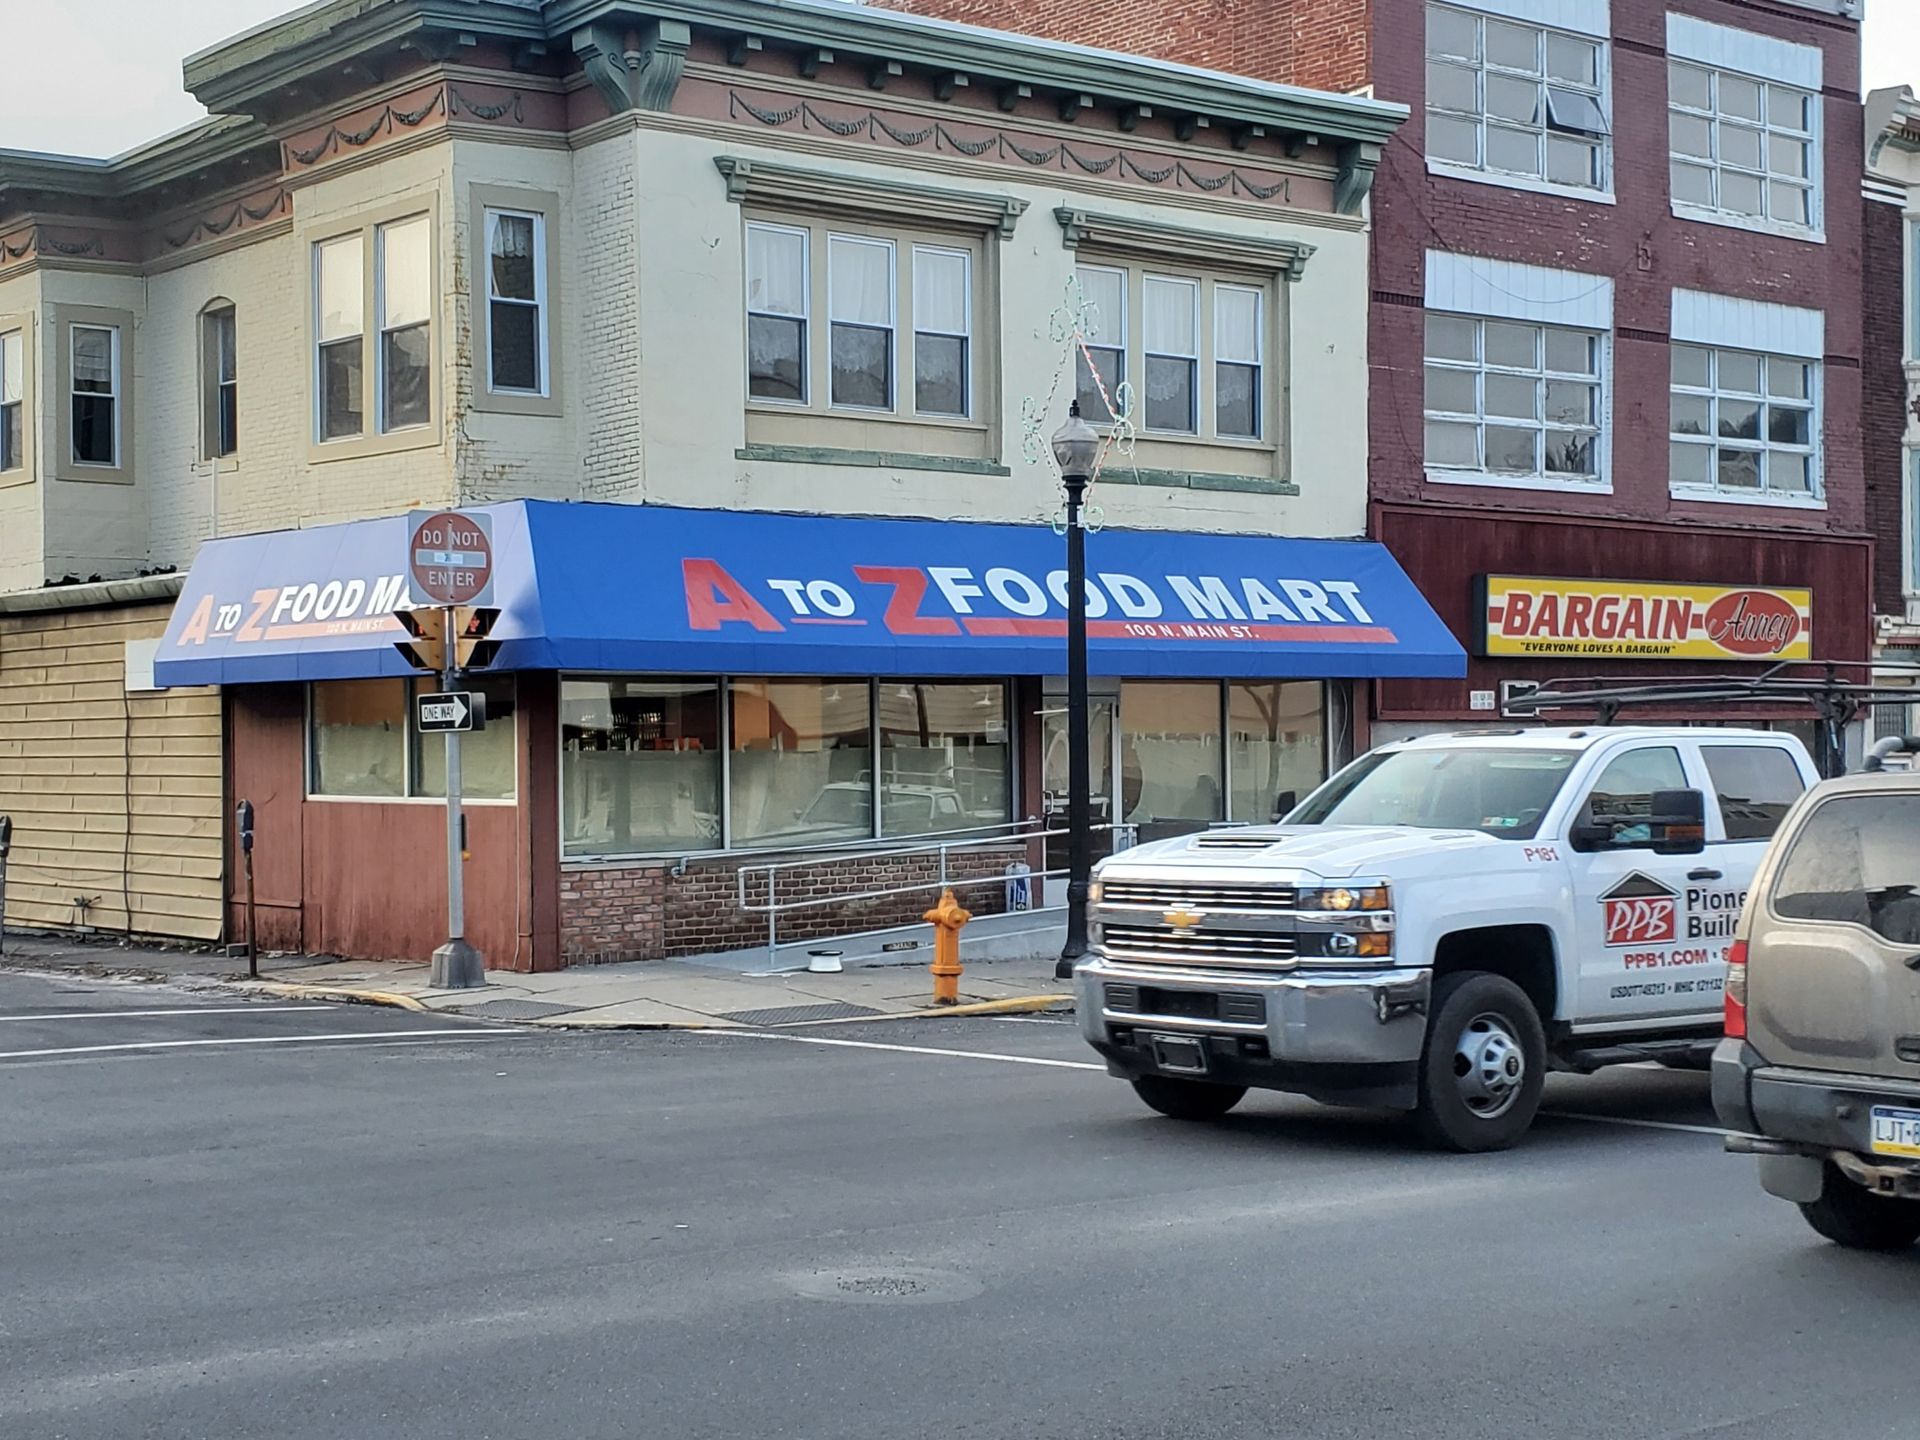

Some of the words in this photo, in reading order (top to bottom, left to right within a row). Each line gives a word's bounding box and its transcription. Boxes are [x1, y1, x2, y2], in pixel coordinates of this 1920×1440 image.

[422, 529, 442, 545] DO
[450, 531, 480, 547] NOT
[428, 570, 475, 587] ENTER
[682, 557, 787, 632] A
[767, 579, 856, 617] TO
[853, 565, 963, 636] Z
[927, 567, 1164, 619] FOOD
[1165, 575, 1374, 624] MART
[177, 594, 215, 646] A
[215, 604, 242, 631] TO
[235, 588, 282, 642] Z
[270, 579, 366, 624] FOOD
[1501, 591, 1693, 640] BARGAIN
[1124, 623, 1158, 637] 100
[1158, 624, 1181, 638] N.
[1180, 624, 1229, 638] MAIN
[1229, 625, 1260, 639] ST.
[1520, 642, 1581, 653] "EVERYONE
[1583, 643, 1614, 653] LOVES
[1615, 644, 1623, 654] A
[1625, 644, 1676, 655] BARGAIN"
[424, 706, 438, 720] ONE
[440, 705, 455, 719] WAY
[1523, 847, 1560, 862] P181
[1607, 900, 1673, 940] PPB
[1624, 949, 1709, 969] PPB1.COM
